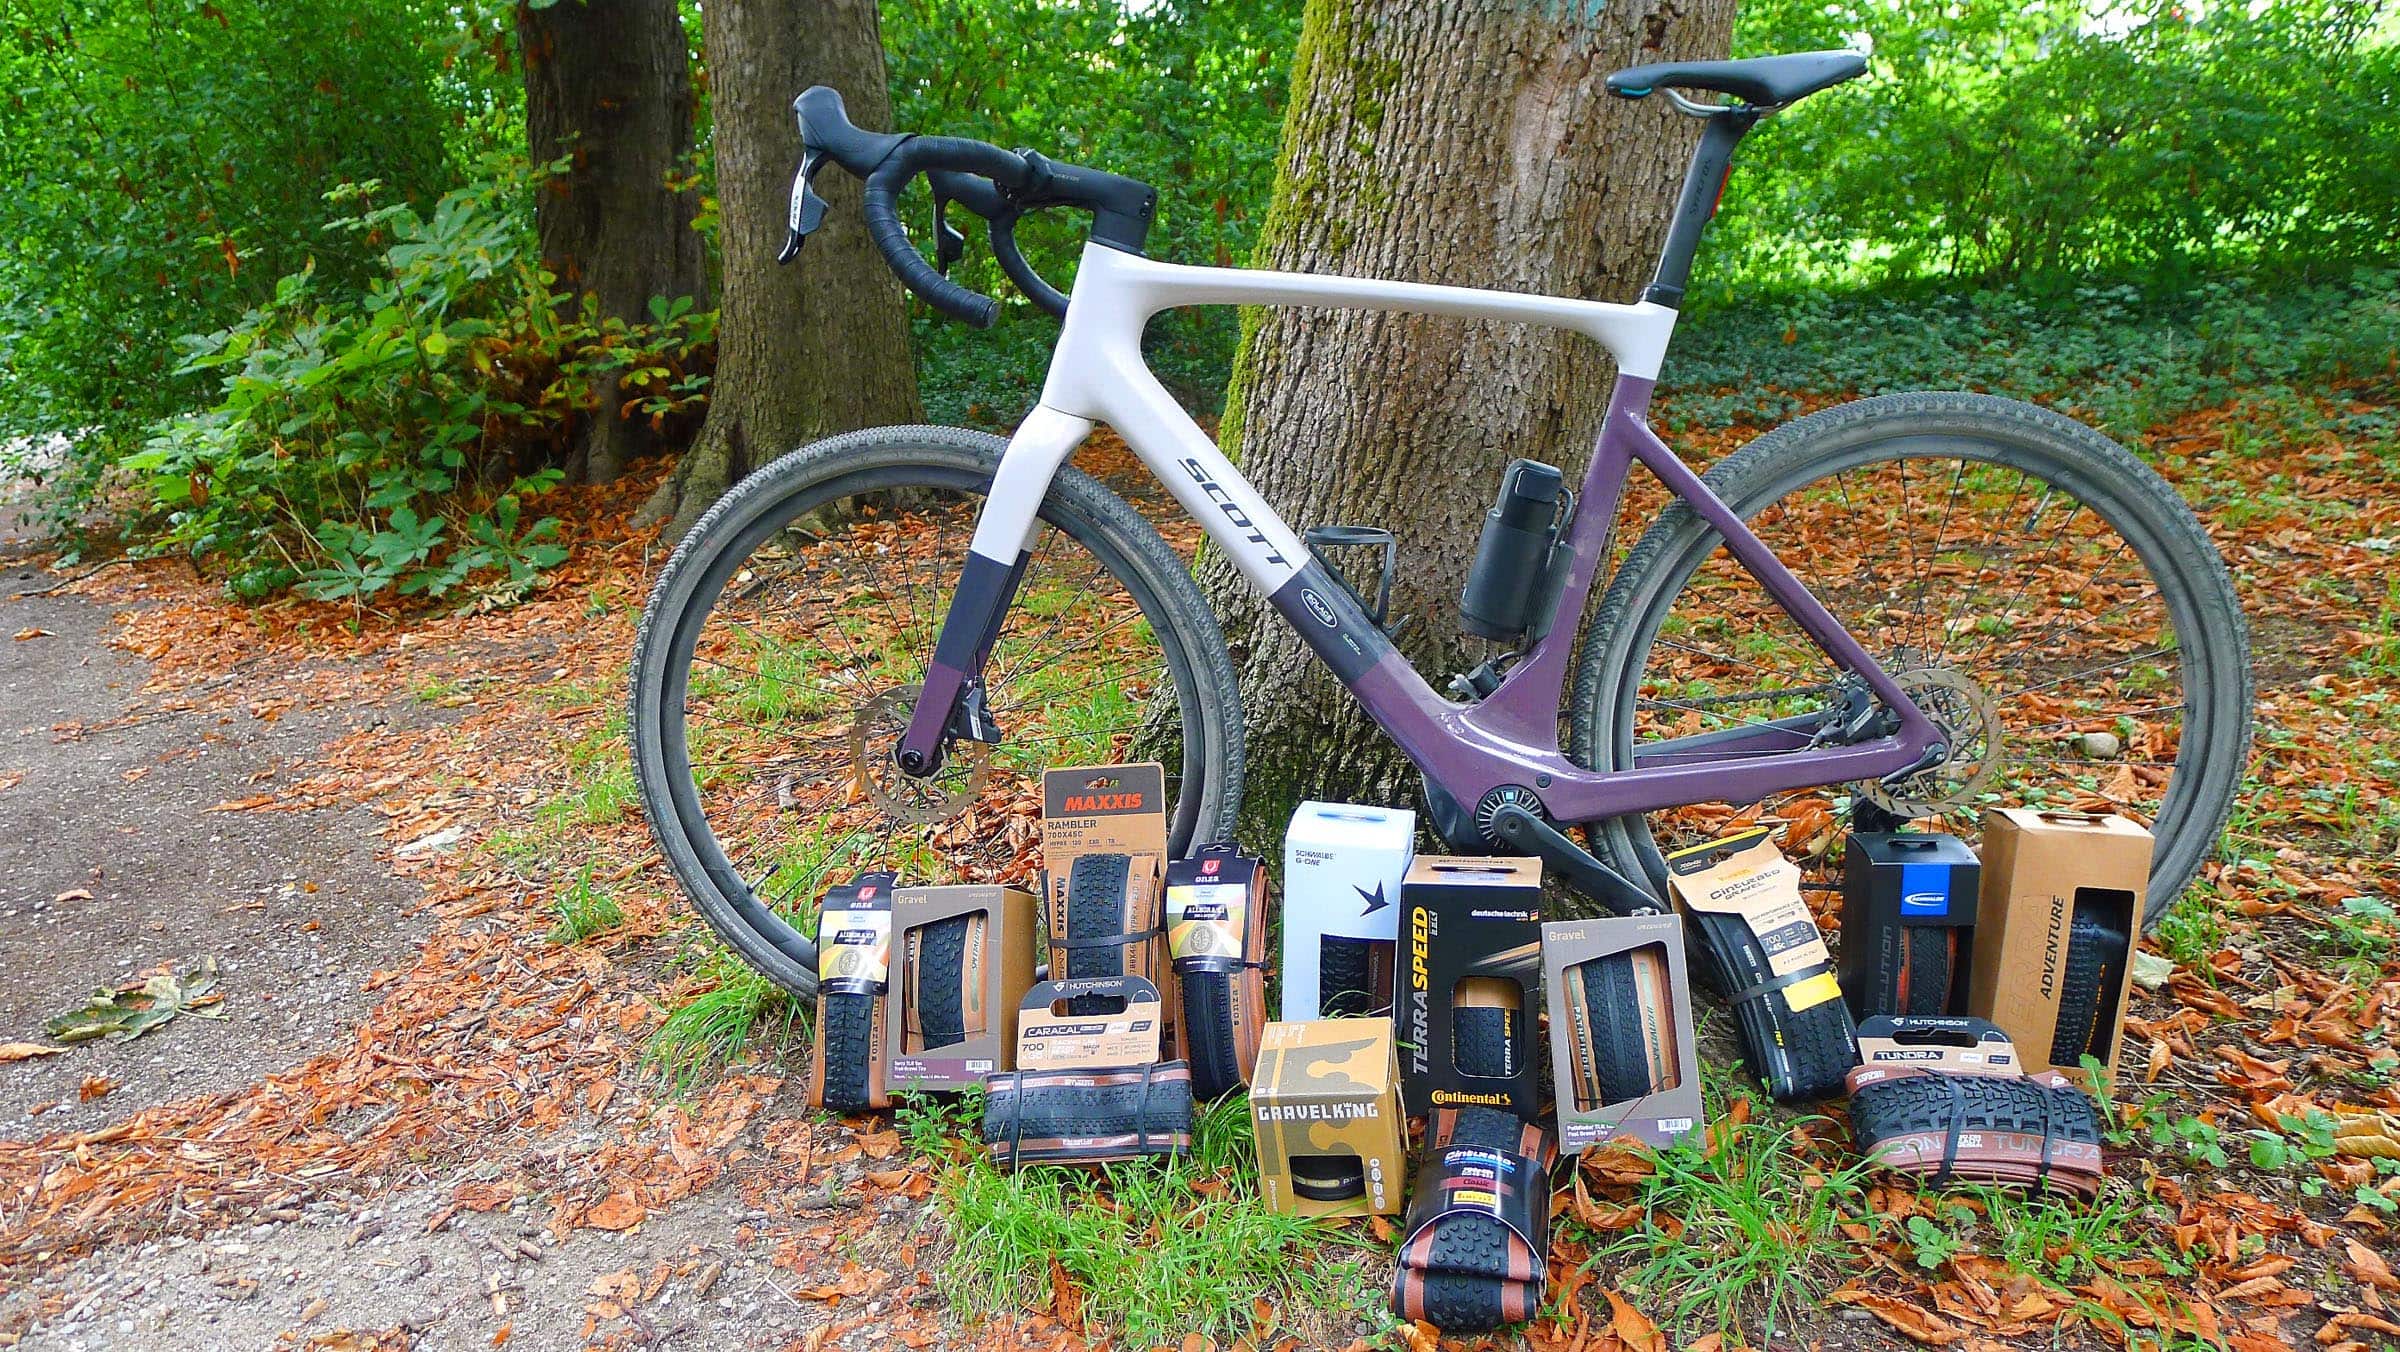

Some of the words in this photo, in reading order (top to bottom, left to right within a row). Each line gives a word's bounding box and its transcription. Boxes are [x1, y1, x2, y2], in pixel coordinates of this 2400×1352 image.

[1177, 458, 1293, 569] SCOTT
[1064, 792, 1143, 812] MAXXIS
[1048, 820, 1097, 830] RAMBLER
[1048, 831, 1083, 839] 700X45C
[1710, 867, 1781, 900] Cinturato
[898, 894, 928, 904] Gravel
[1056, 875, 1066, 932] MAXXIS
[1549, 929, 1586, 942] Gravel
[1764, 934, 1781, 945] 700
[2040, 895, 2065, 1001] ADVENTURE
[1070, 981, 1122, 990] HUTCHINSON
[1909, 1018, 1968, 1026] HUTCHINSON
[1028, 1026, 1078, 1036] CARACAL
[1022, 1043, 1044, 1052] 700
[1573, 1006, 1591, 1078] PATHFINDER
[1504, 1039, 1512, 1076] TERRA
[1877, 1052, 1941, 1060] TUNDRA
[1431, 1089, 1500, 1104] Continental
[1258, 1103, 1379, 1121] GRAVELKING
